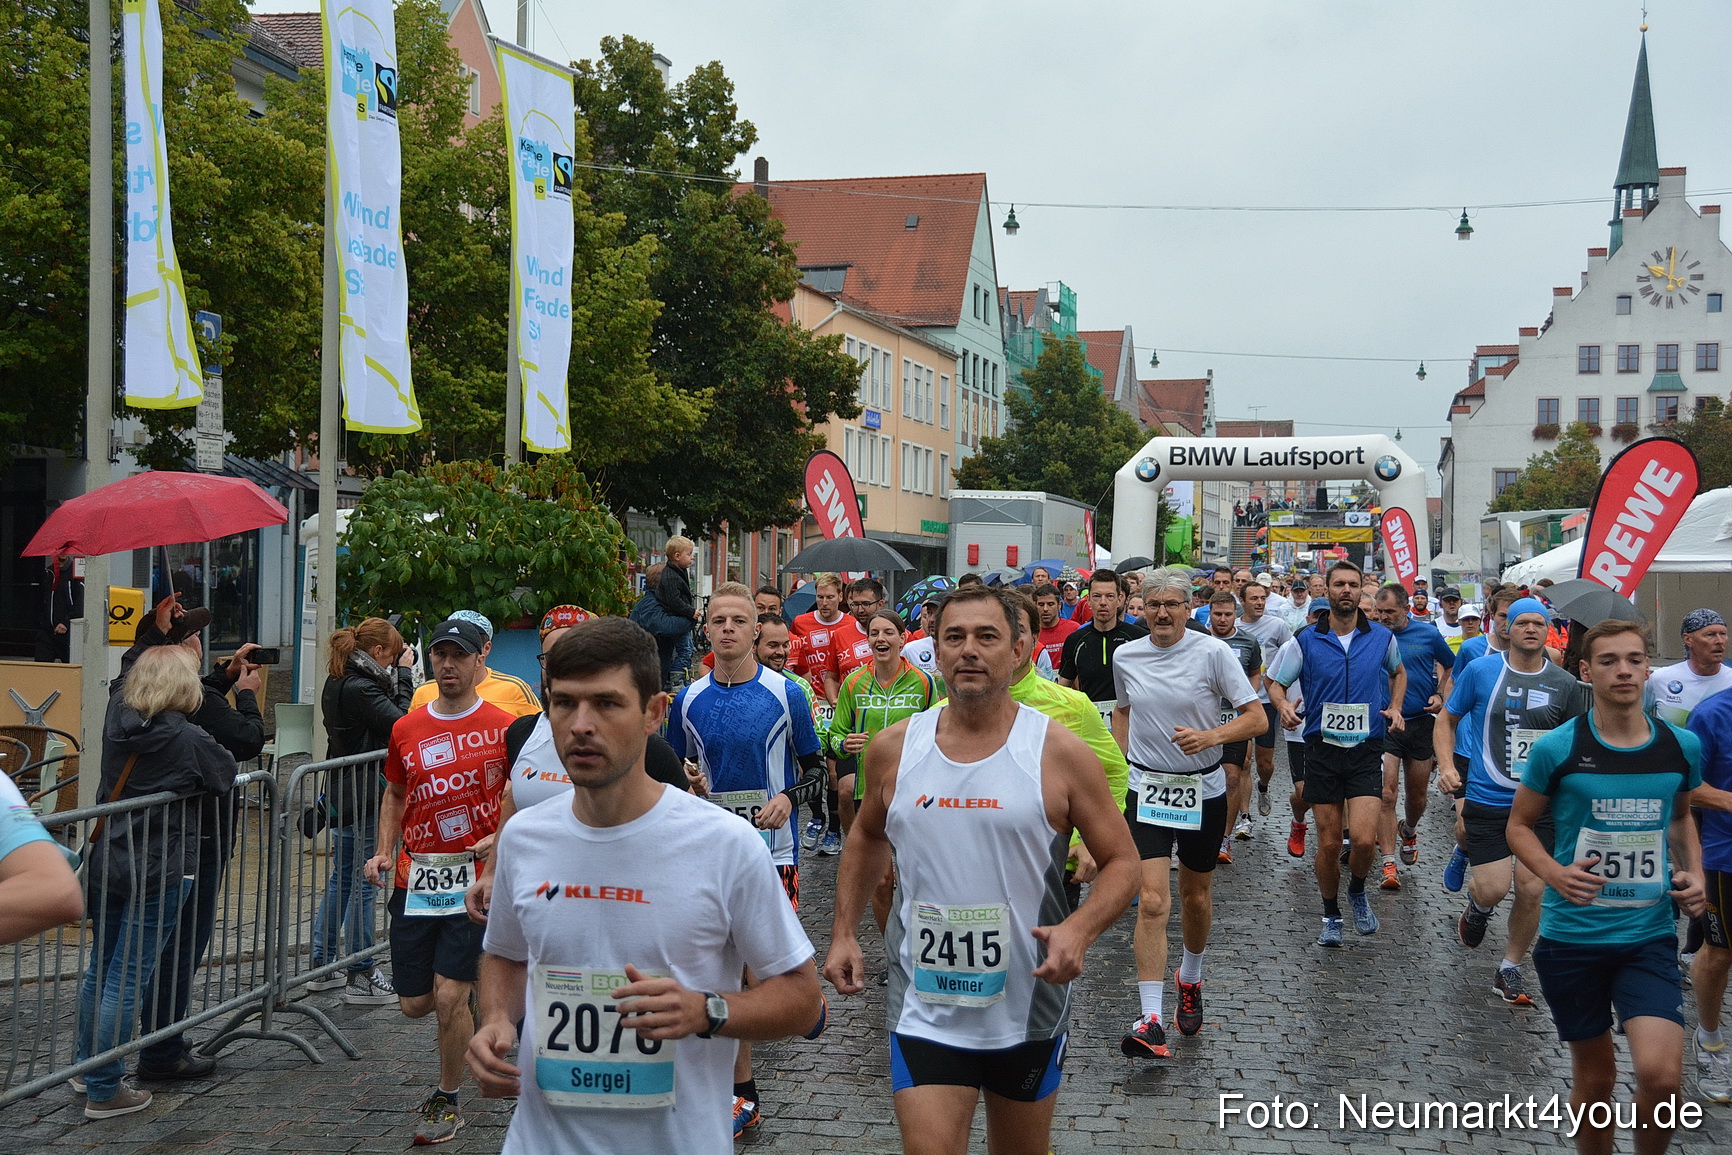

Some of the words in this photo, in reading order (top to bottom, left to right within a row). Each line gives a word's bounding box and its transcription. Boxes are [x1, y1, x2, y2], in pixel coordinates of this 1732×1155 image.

[1169, 446, 1237, 466] BMW
[1243, 446, 1365, 470] Laufsport
[1589, 458, 1683, 592] REWE
[1309, 530, 1332, 540] ZIEL
[855, 694, 924, 709] BOCK
[1326, 714, 1363, 730] 2281
[420, 735, 450, 749] raumbox
[460, 748, 497, 760] schenken
[1145, 784, 1196, 808] 2423
[938, 798, 1004, 809] KLEBL
[1592, 798, 1662, 812] HUBER
[437, 808, 466, 820] raumbox
[1150, 810, 1188, 821] Bernhard
[1618, 834, 1655, 844] BOCK
[1585, 850, 1654, 879] 2515
[414, 865, 469, 890] 2634
[565, 885, 650, 904] KLEBL
[1602, 885, 1635, 897] Lukas
[426, 897, 456, 906] Tobias
[948, 908, 1000, 921] BOCK
[919, 928, 1002, 968] 2415
[546, 982, 584, 991] NeuerMarkt
[936, 975, 983, 992] Werner
[571, 1067, 630, 1093] Sergej
